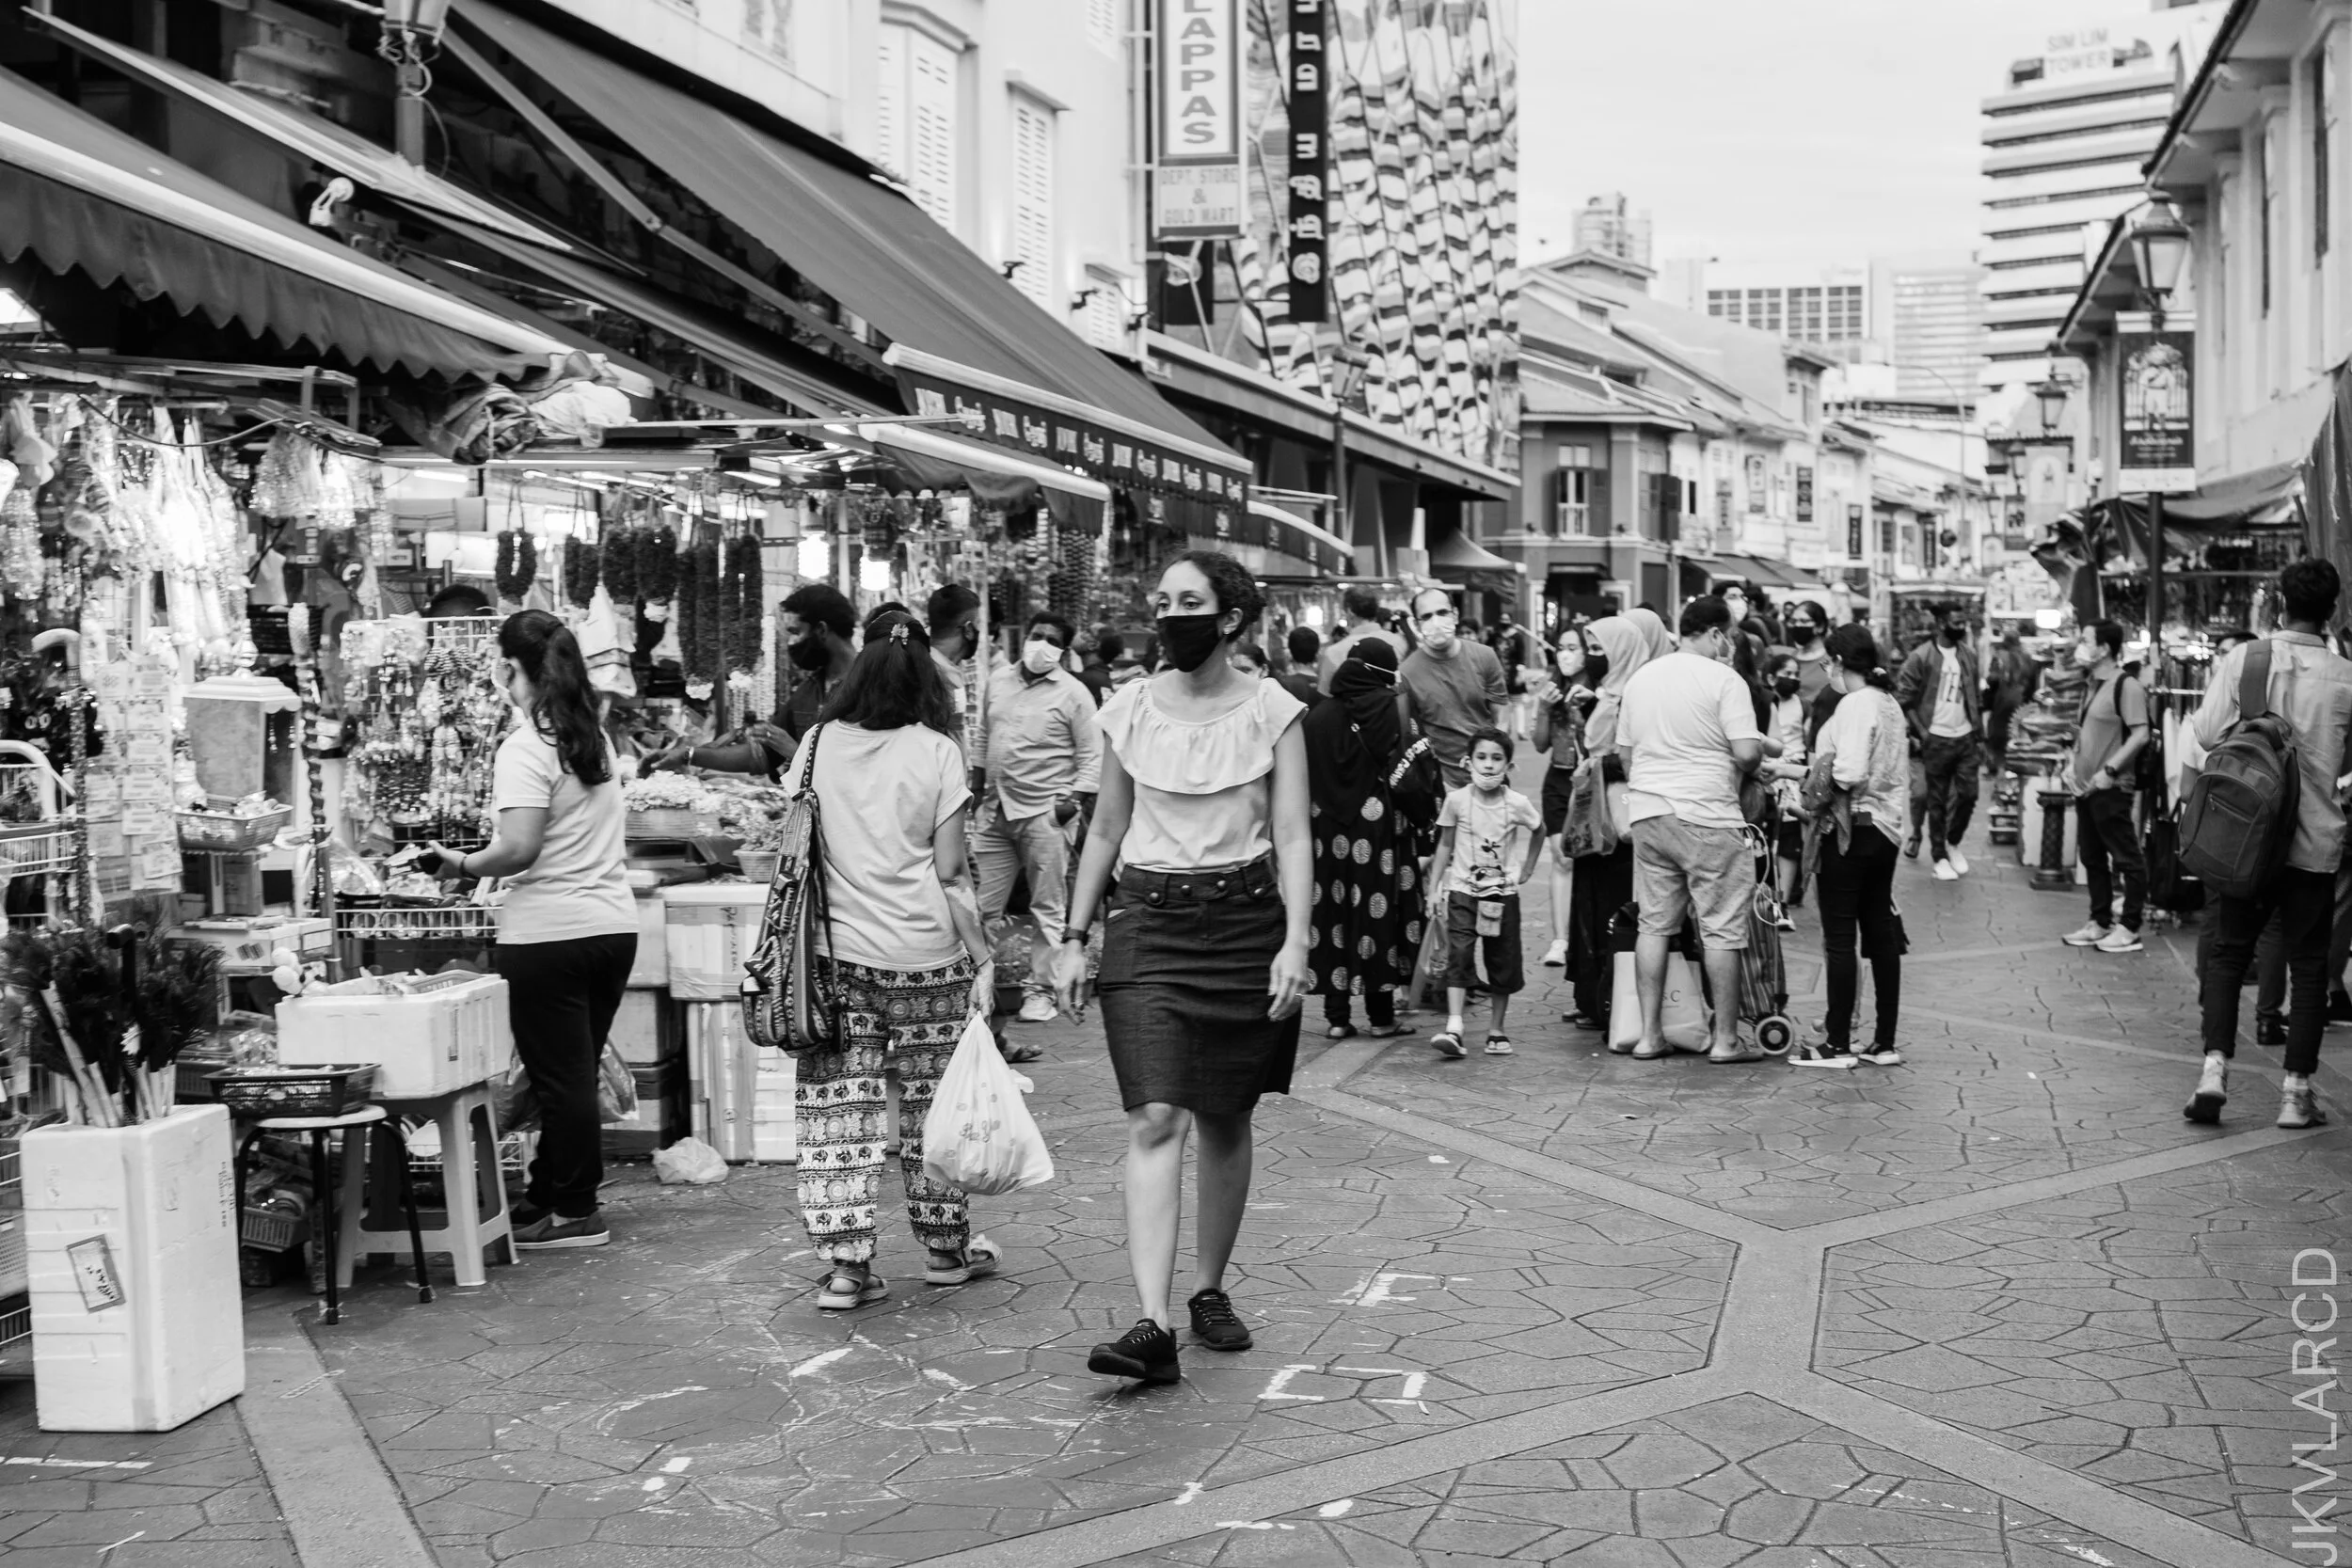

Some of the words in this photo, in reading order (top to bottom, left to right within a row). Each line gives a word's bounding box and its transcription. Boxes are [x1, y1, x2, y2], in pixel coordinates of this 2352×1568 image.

[2047, 34, 2075, 53] SIM
[2080, 26, 2108, 48] LIM
[2048, 50, 2108, 74] TOWER
[1199, 167, 1239, 184] STORE
[1191, 188, 1207, 204] &
[1165, 207, 1194, 225] GOLD
[1200, 206, 1235, 223] MART
